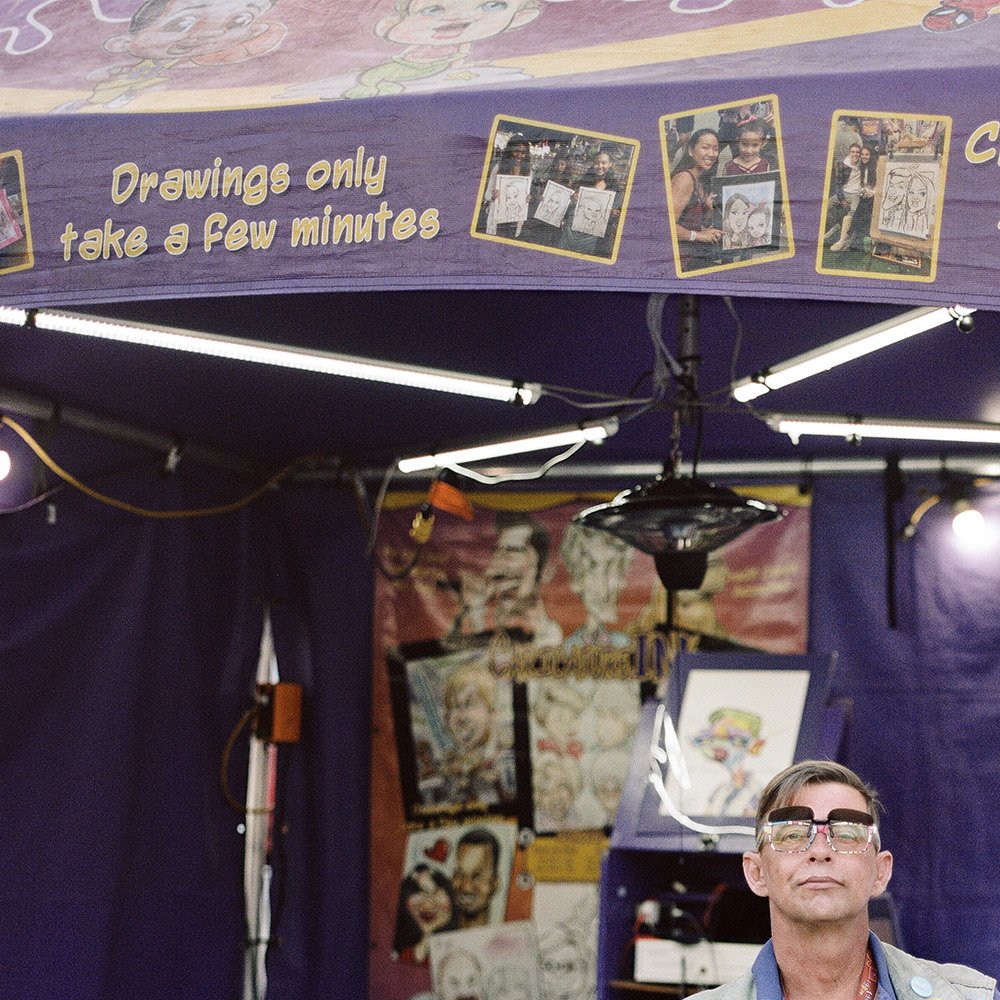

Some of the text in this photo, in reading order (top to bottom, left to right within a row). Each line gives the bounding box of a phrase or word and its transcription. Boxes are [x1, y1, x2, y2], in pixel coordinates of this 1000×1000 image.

[111, 145, 387, 205] Drawings only
[60, 202, 441, 261] take a few minutes
